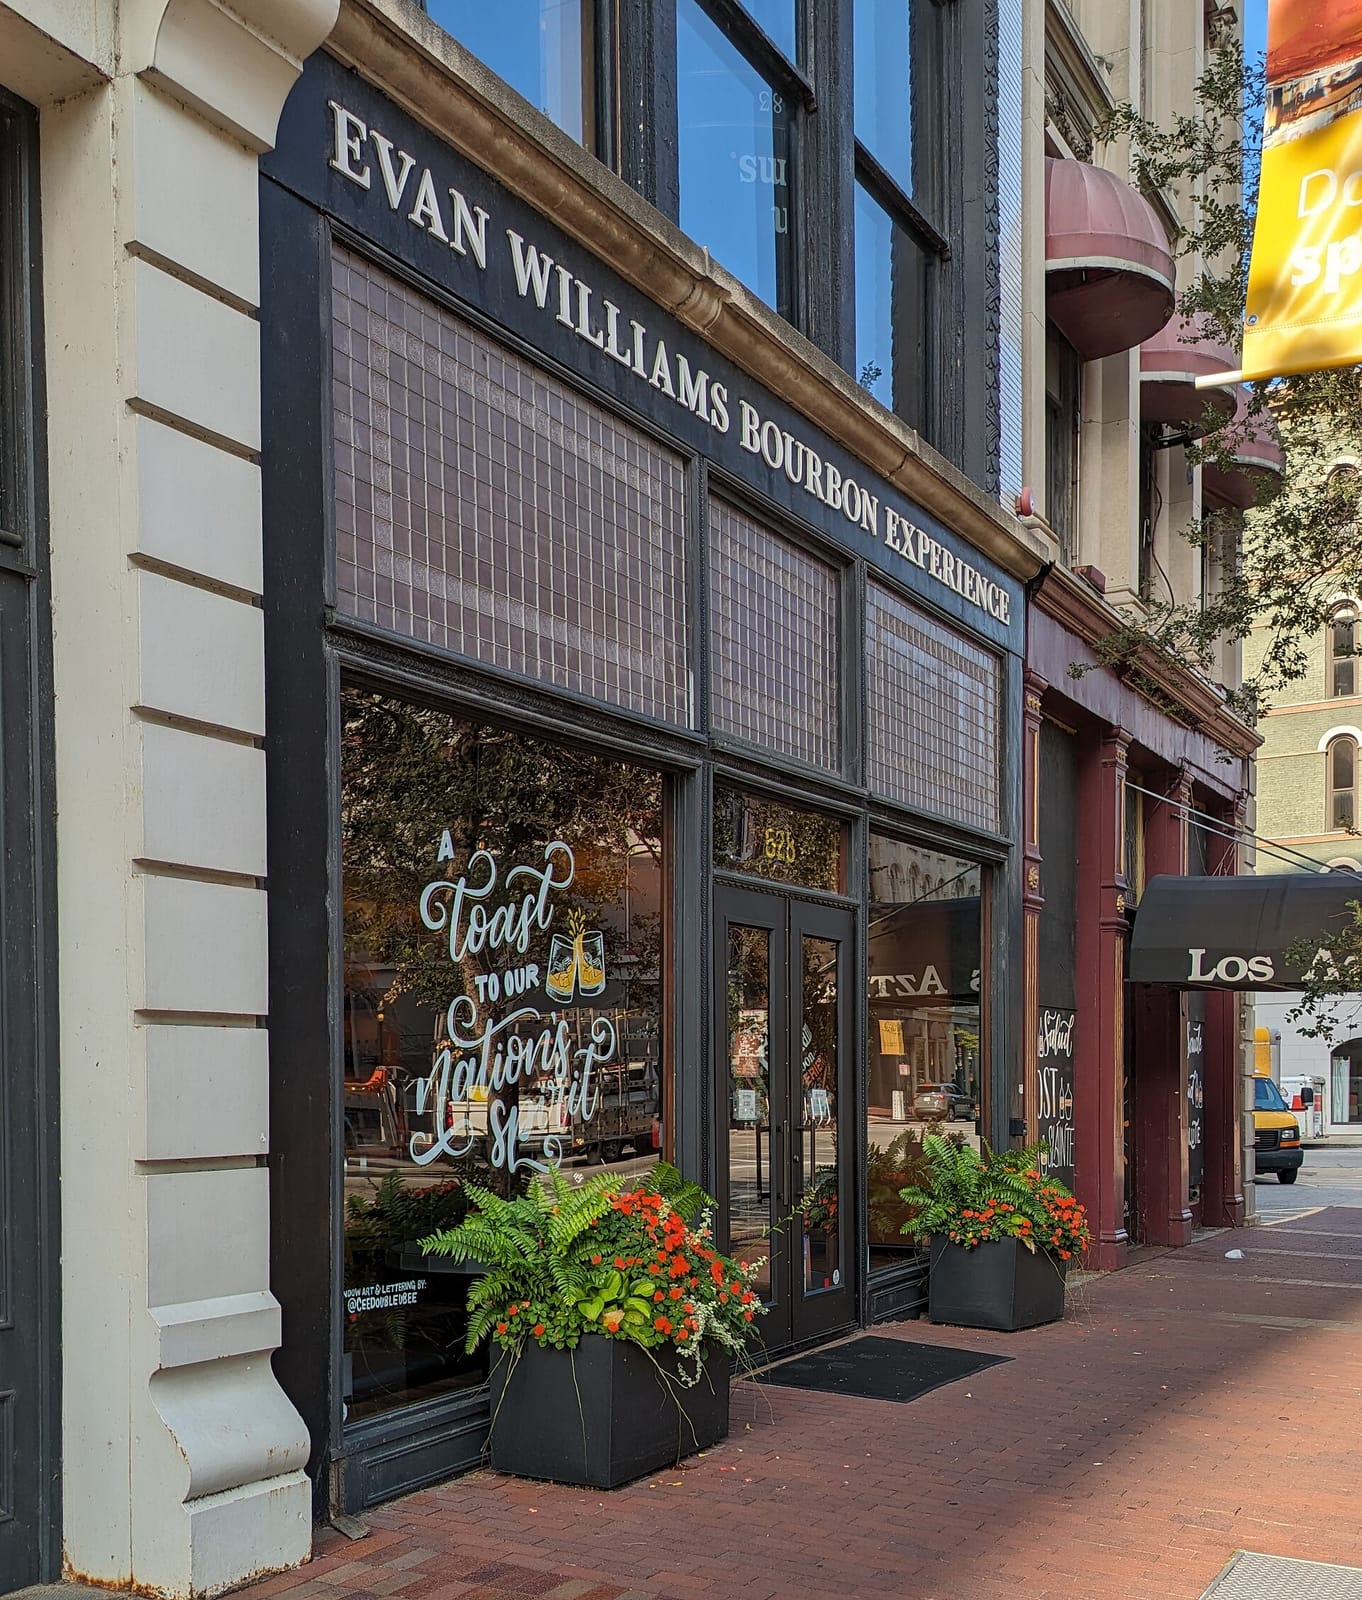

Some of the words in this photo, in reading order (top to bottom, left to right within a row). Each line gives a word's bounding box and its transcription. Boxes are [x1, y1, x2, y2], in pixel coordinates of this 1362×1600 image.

[328, 99, 490, 269] EVAN
[506, 229, 729, 433] WILLIAMS
[739, 400, 878, 536] BOURBON
[884, 506, 1011, 626] EXPERIENCE
[437, 830, 455, 862] A
[420, 840, 575, 962] Toast
[475, 974, 499, 1003] TO
[504, 963, 539, 1000] OUR
[361, 1286, 375, 1297] ART
[374, 1283, 382, 1296] &
[382, 1280, 416, 1294] LETTERING
